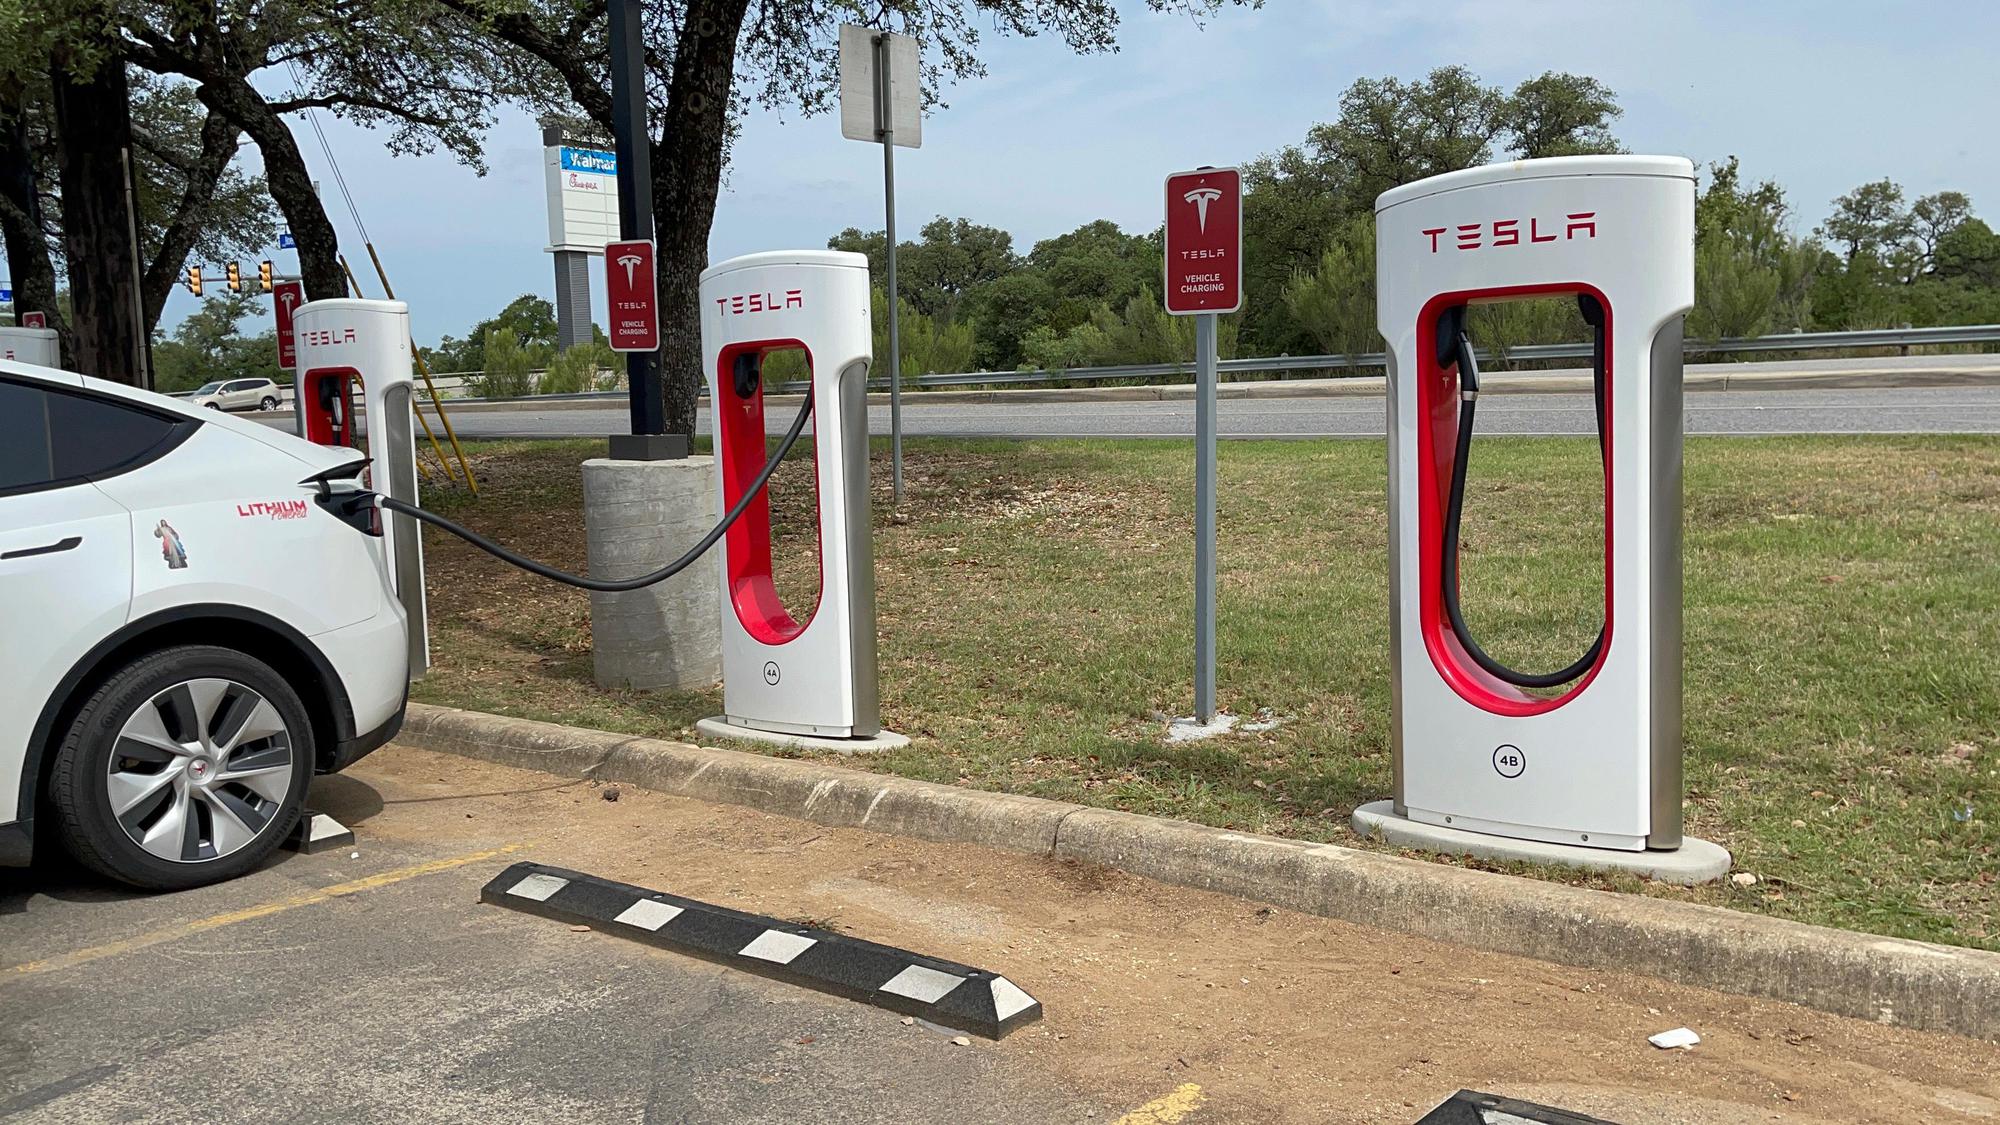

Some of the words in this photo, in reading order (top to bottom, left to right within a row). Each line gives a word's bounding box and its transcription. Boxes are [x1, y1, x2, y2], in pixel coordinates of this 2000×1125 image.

[570, 152, 616, 170] Walmar
[1422, 212, 1596, 253] TESLA
[1181, 248, 1225, 259] TESLA
[1185, 273, 1221, 283] VEHICLE
[1180, 283, 1225, 293] CHARGING
[716, 290, 802, 316] TESLA
[301, 329, 356, 347] TESLA
[619, 328, 649, 336] CHARGING
[237, 500, 307, 516] LITHIUM
[270, 506, 308, 521] Powered
[767, 668, 777, 677] 4A
[1499, 755, 1519, 766] 4B
